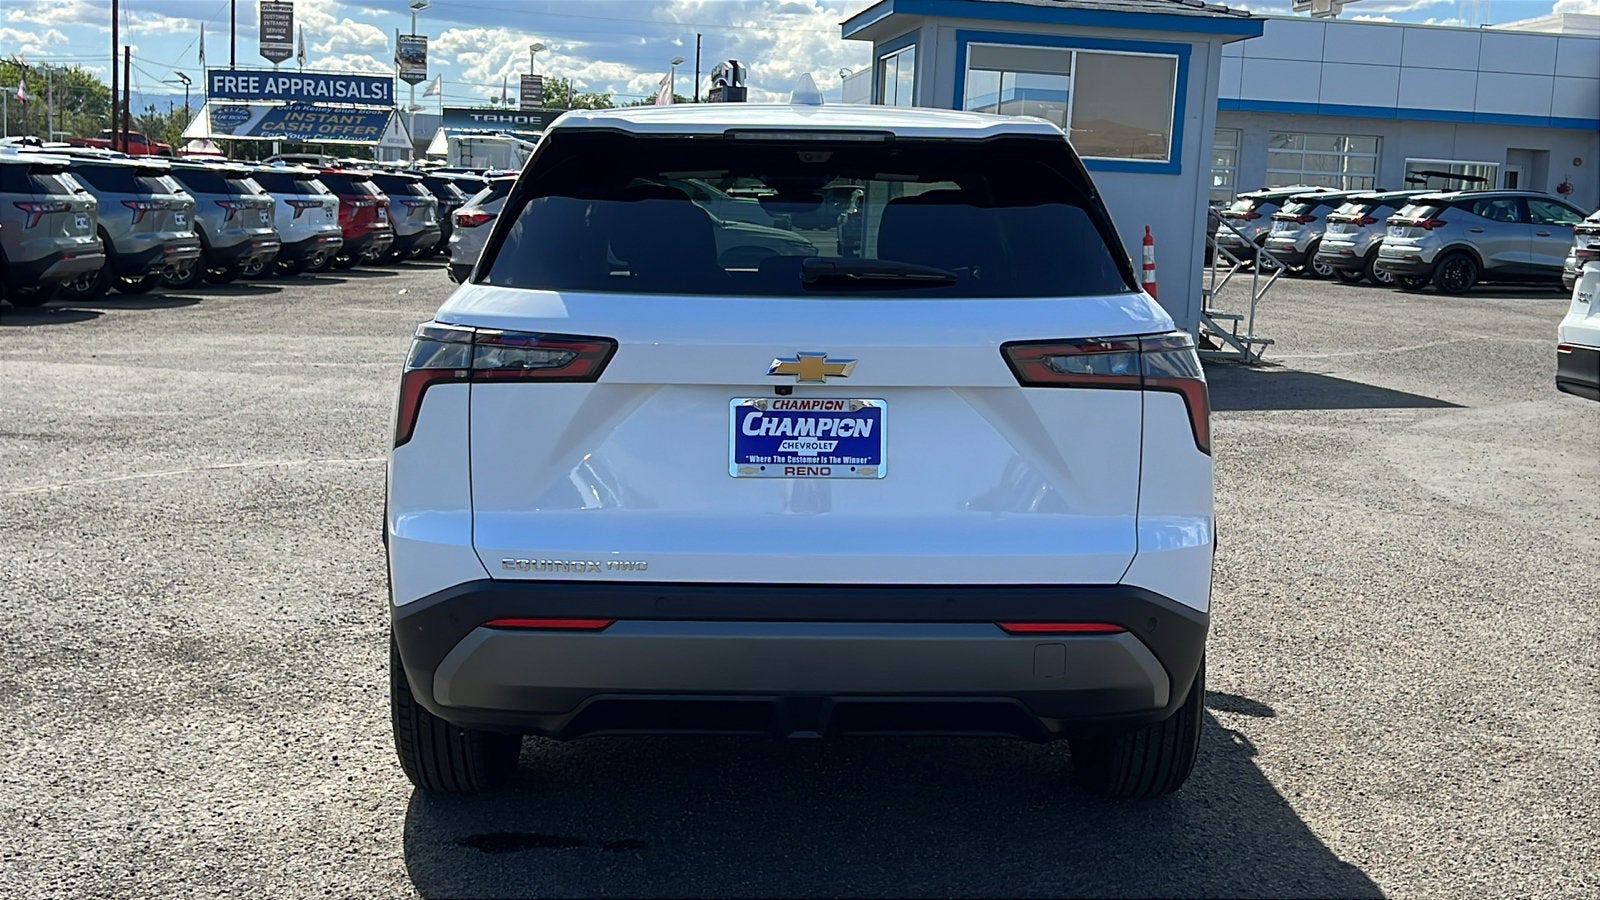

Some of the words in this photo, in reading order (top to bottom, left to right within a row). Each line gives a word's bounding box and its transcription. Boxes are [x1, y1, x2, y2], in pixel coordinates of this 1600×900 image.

[213, 75, 260, 94] FREE
[264, 77, 388, 99] APPRAISALS!
[284, 112, 367, 124] INSTANT
[470, 114, 542, 125] TAHOE
[261, 121, 314, 132] CASH
[318, 124, 378, 135] OFFER
[772, 400, 844, 410] CHAMPION
[742, 411, 873, 438] CHAMPION
[782, 441, 834, 450] CHEVROLET
[784, 466, 832, 476] RENO
[502, 558, 602, 573] EQUINOX
[606, 560, 648, 571] AWD
